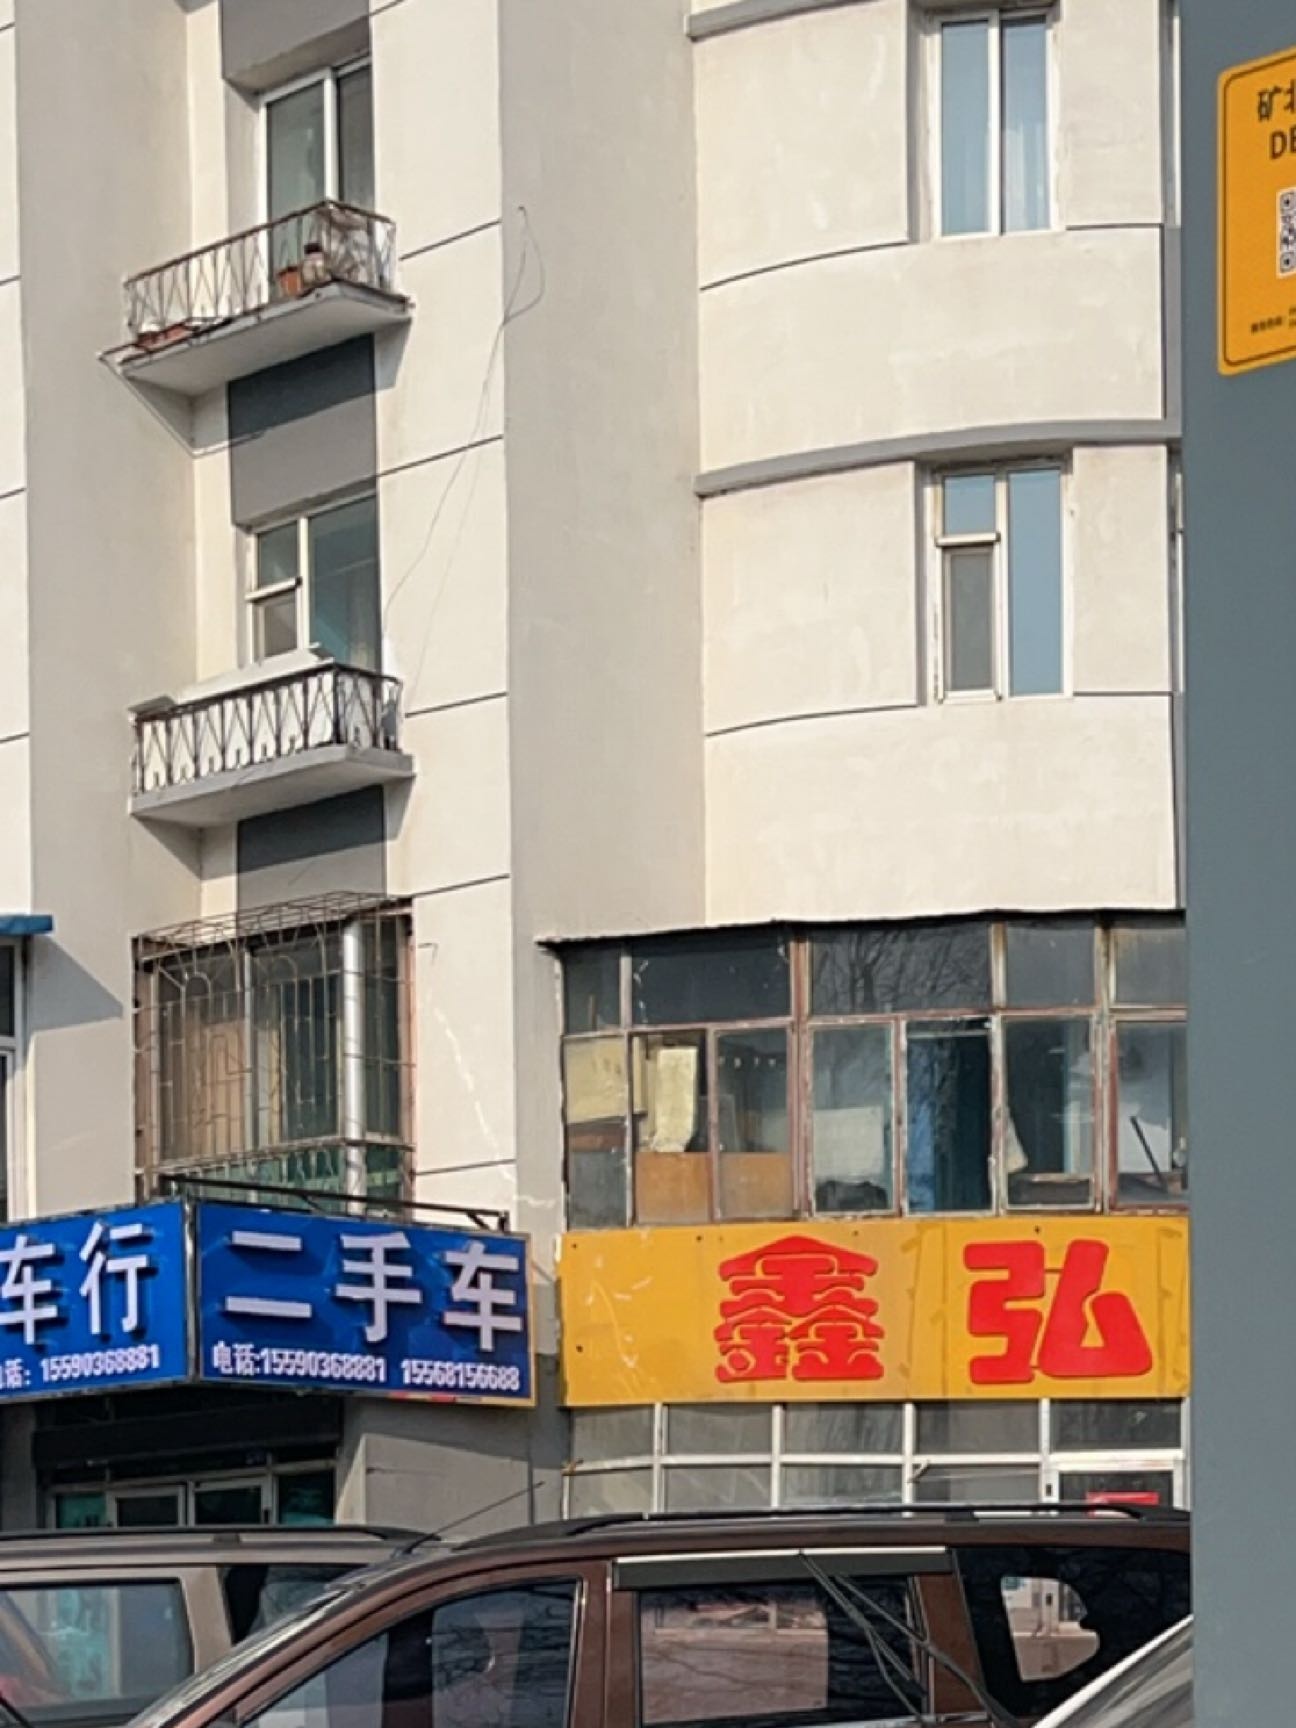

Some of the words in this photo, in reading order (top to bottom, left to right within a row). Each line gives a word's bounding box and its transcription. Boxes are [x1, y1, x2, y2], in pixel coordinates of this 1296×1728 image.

[0, 1221, 150, 1345] 车行
[224, 1229, 523, 1353] 二手车
[714, 1235, 1152, 1385] 鑫弘
